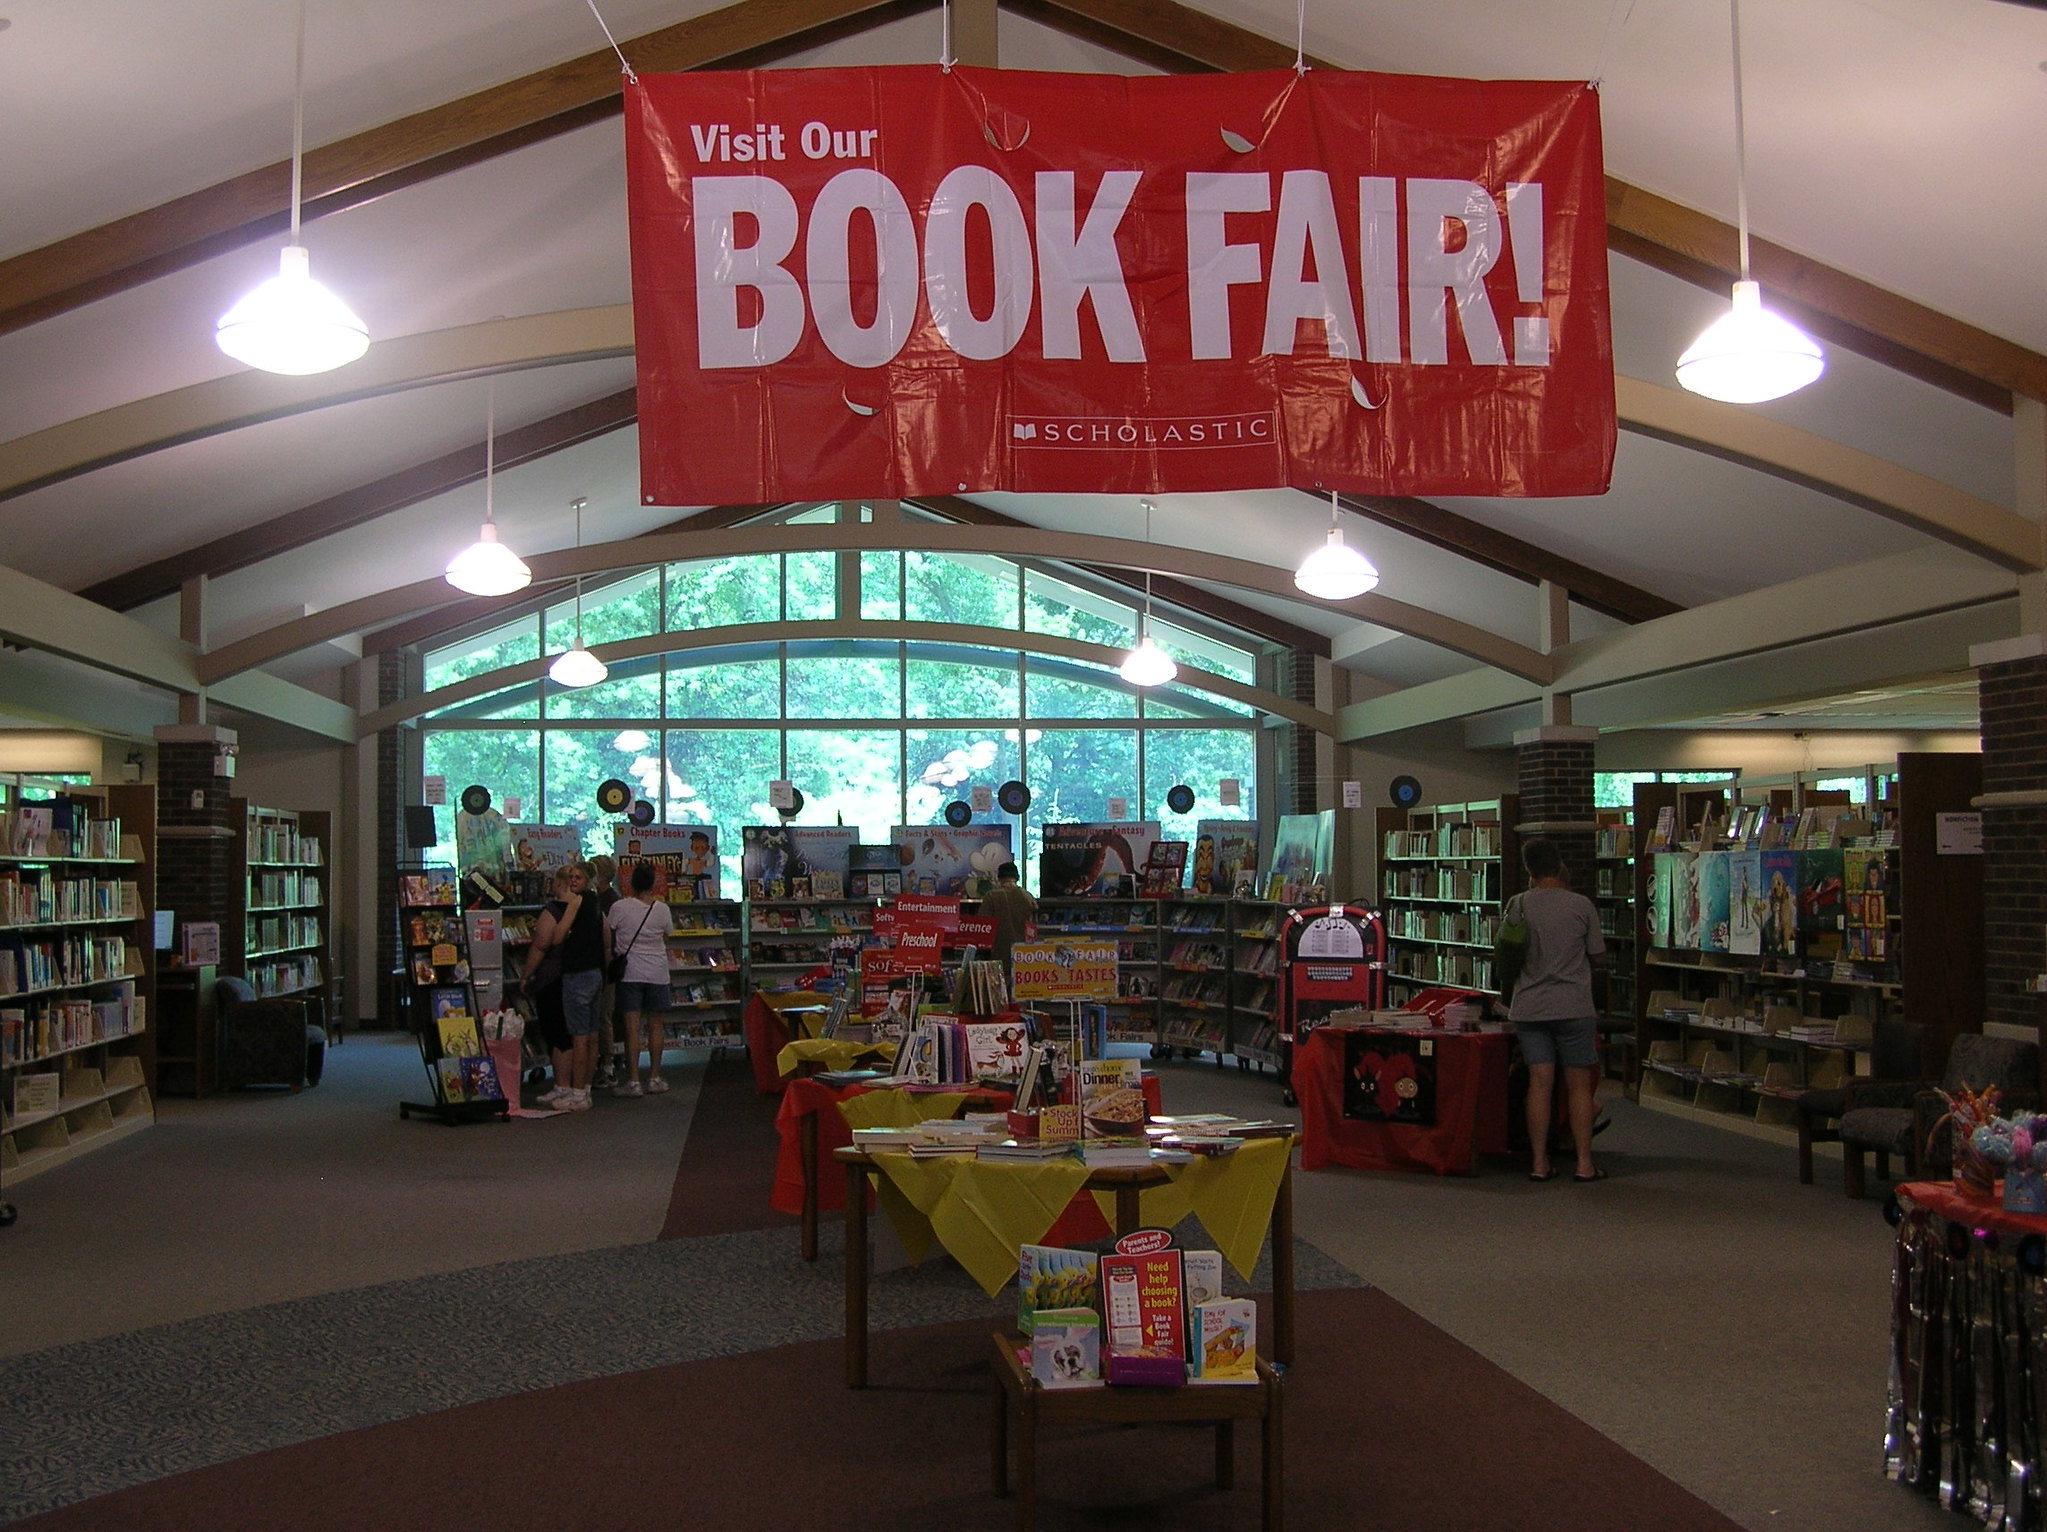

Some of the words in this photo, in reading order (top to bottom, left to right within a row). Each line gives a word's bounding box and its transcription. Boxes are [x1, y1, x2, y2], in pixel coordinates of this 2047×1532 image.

[690, 123, 786, 162] Visit
[801, 121, 877, 160] Our
[691, 166, 1148, 370] BOOK
[1186, 170, 1551, 368] FAIR!
[1044, 419, 1268, 443] SCHOLASTIC
[631, 827, 660, 840] Chapter
[662, 828, 685, 838] Books
[795, 830, 824, 838] Advanced
[826, 830, 851, 838] Readers
[905, 830, 922, 838] Facts
[932, 830, 947, 838] Stats
[1112, 825, 1145, 836] Fantasy
[1044, 842, 1102, 850] TENTACLES
[897, 901, 957, 914] Entertainment
[959, 922, 992, 934] erence
[901, 932, 938, 947] Preschool
[1016, 950, 1055, 963] BOOK
[1077, 949, 1116, 962] FAIR
[1015, 969, 1058, 984] BOOKS
[1070, 968, 1117, 981] TASTES
[684, 1039, 705, 1047] Book
[709, 1037, 729, 1046] Fairs
[1120, 1032, 1144, 1042] Fairs
[1083, 1072, 1120, 1085] Dinner
[1050, 1109, 1078, 1117] Stock
[1057, 1117, 1072, 1126] Up
[1122, 1237, 1149, 1248] Parents
[1149, 1233, 1162, 1241] and
[1127, 1240, 1160, 1254] Teachers!
[1147, 1262, 1169, 1272] Need
[1149, 1274, 1169, 1284] help
[1142, 1286, 1178, 1297] choosing
[1151, 1297, 1177, 1308] book?
[1152, 1314, 1167, 1322] Take
[1155, 1322, 1170, 1330] Book
[1154, 1338, 1174, 1347] guide!
